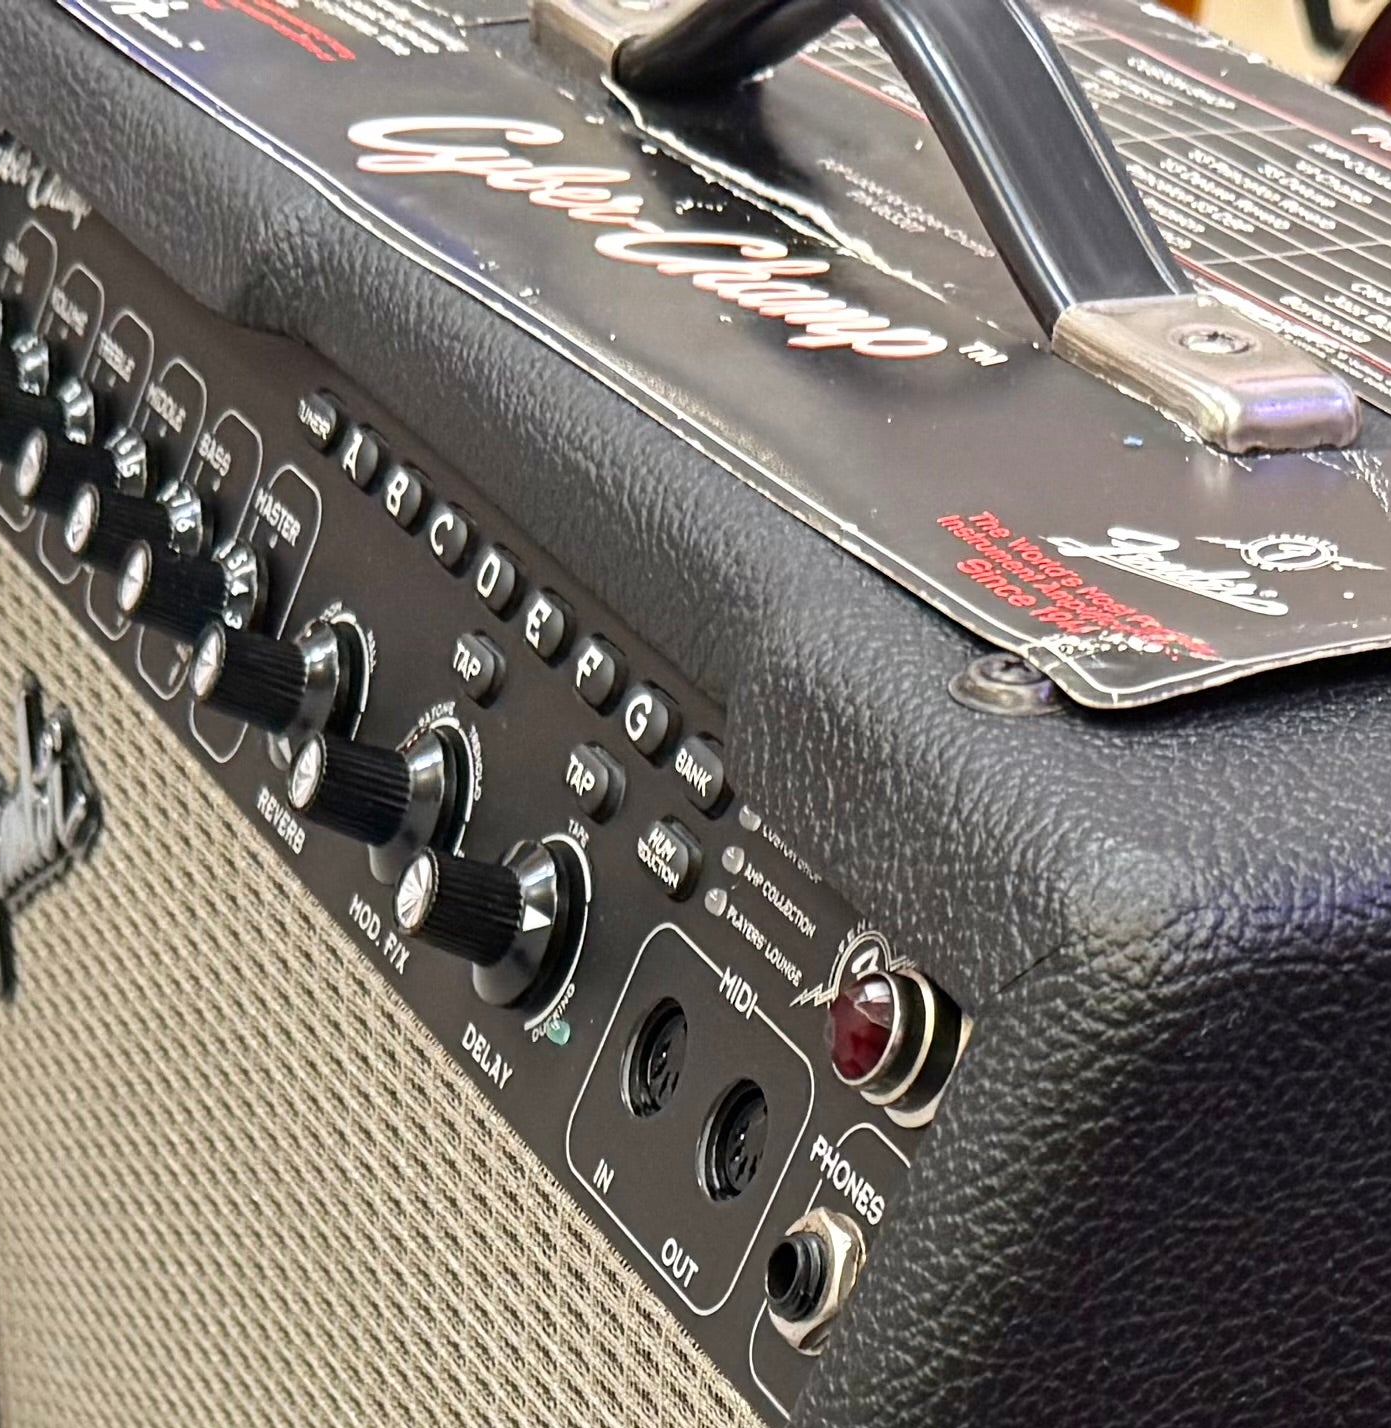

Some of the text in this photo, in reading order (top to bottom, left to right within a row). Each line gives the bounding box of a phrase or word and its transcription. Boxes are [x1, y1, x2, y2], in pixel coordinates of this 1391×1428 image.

[348, 117, 662, 234] Cyber
[594, 230, 948, 358] Champ
[196, 431, 232, 478] BASS
[341, 428, 364, 481] A
[254, 486, 302, 548] MASTER
[385, 470, 410, 518] B
[429, 512, 454, 557] C
[936, 513, 1046, 594] Instrument
[968, 510, 1011, 540] The
[1008, 535, 1083, 590] World's
[476, 552, 501, 599] D
[957, 556, 1037, 608] Since
[525, 597, 553, 650] E
[451, 641, 483, 683] TAP
[575, 644, 604, 689] F
[624, 693, 654, 743] G
[564, 755, 596, 796] TAP
[674, 746, 713, 798] BANK
[257, 786, 307, 855] REVERB
[647, 826, 678, 862] HUM
[348, 892, 381, 947] MOD.
[743, 861, 765, 889] AMP
[762, 879, 817, 939] COLLECTION
[725, 903, 804, 988] PLAYERS' LOUNGE
[718, 965, 759, 1020] MIDI
[461, 1021, 514, 1090] DELAY
[592, 1157, 614, 1195] IN
[809, 1134, 887, 1226] PHONES
[660, 1237, 699, 1288] OUT
